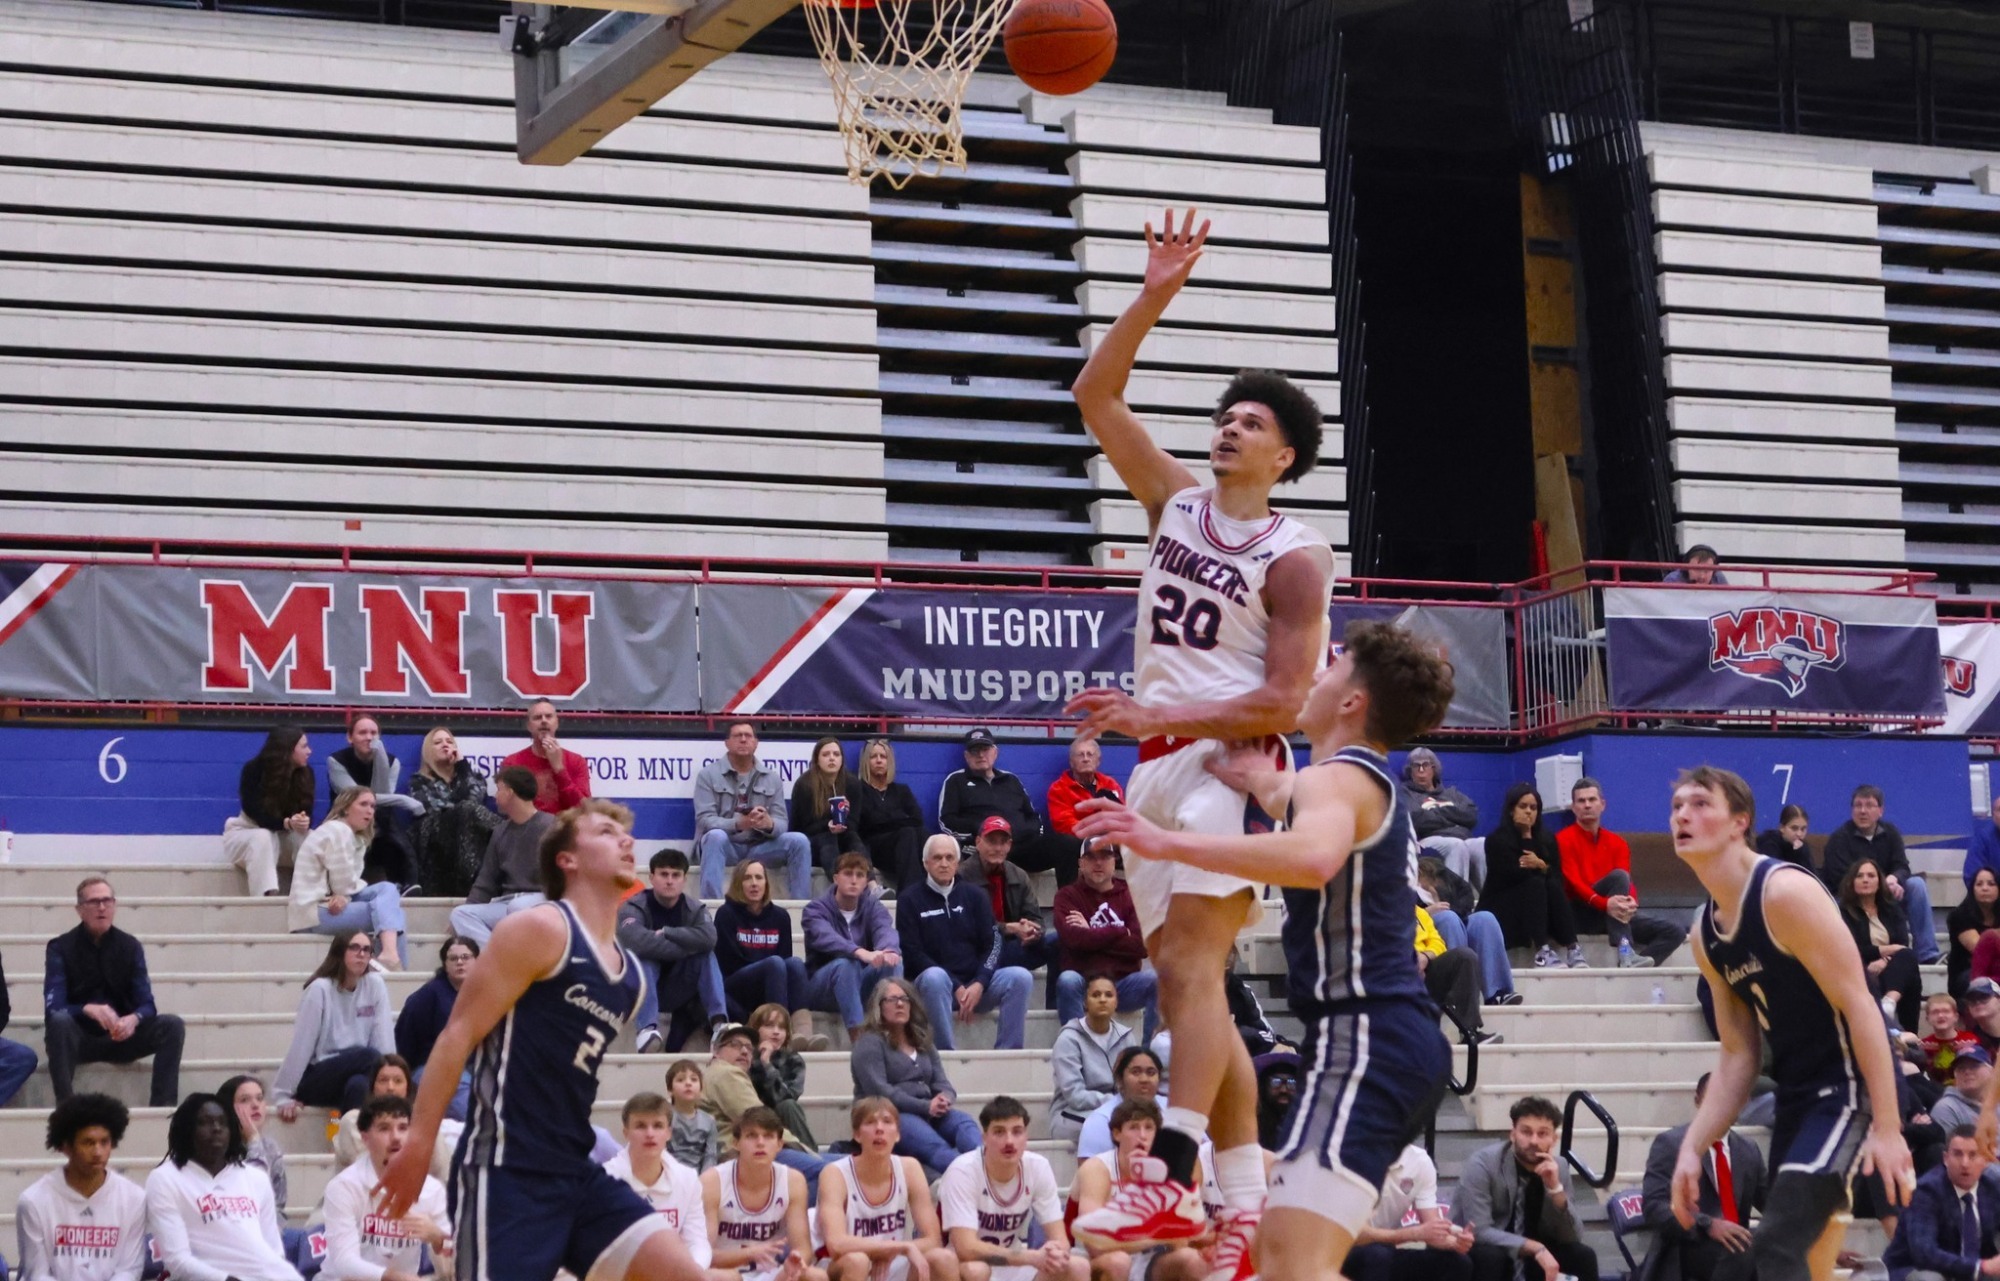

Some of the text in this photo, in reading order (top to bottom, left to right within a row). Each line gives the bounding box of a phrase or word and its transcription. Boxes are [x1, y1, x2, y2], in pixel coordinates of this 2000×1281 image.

[200, 579, 596, 700] MNU
[923, 606, 1105, 649] INTEGRITY
[1151, 584, 1222, 651] 20
[1710, 608, 1841, 664] MNU
[98, 736, 128, 784] 6
[637, 757, 694, 781] MNU
[1772, 763, 1794, 806] 7
[572, 1024, 606, 1076] 2
[55, 1226, 119, 1246] PIONEERS
